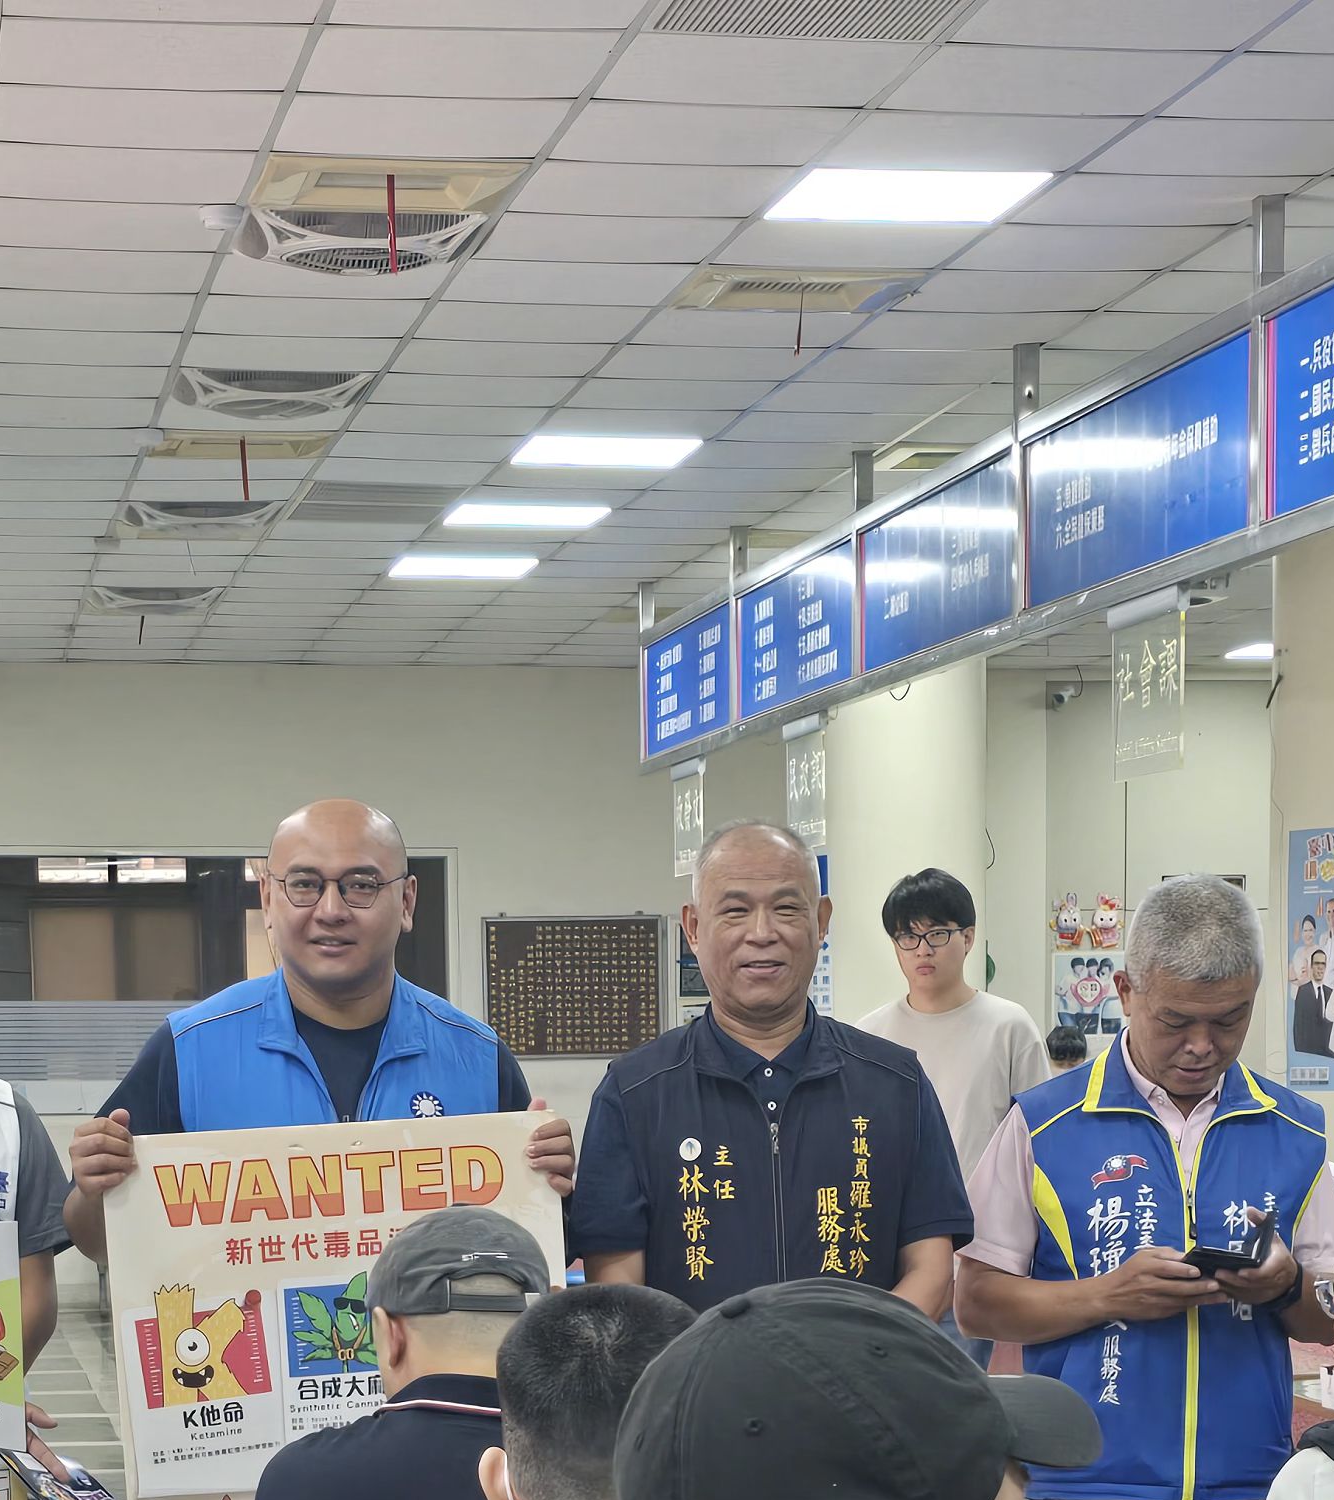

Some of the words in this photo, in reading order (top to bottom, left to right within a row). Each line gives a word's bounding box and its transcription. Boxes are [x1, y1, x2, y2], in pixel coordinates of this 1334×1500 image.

[153, 1144, 504, 1228] WANTED
[713, 1145, 735, 1200] 主任
[678, 1164, 715, 1281] 林榮賢
[817, 1186, 847, 1274] 服務處
[183, 1401, 244, 1429] K他命
[190, 1428, 243, 1441] Ketamine
